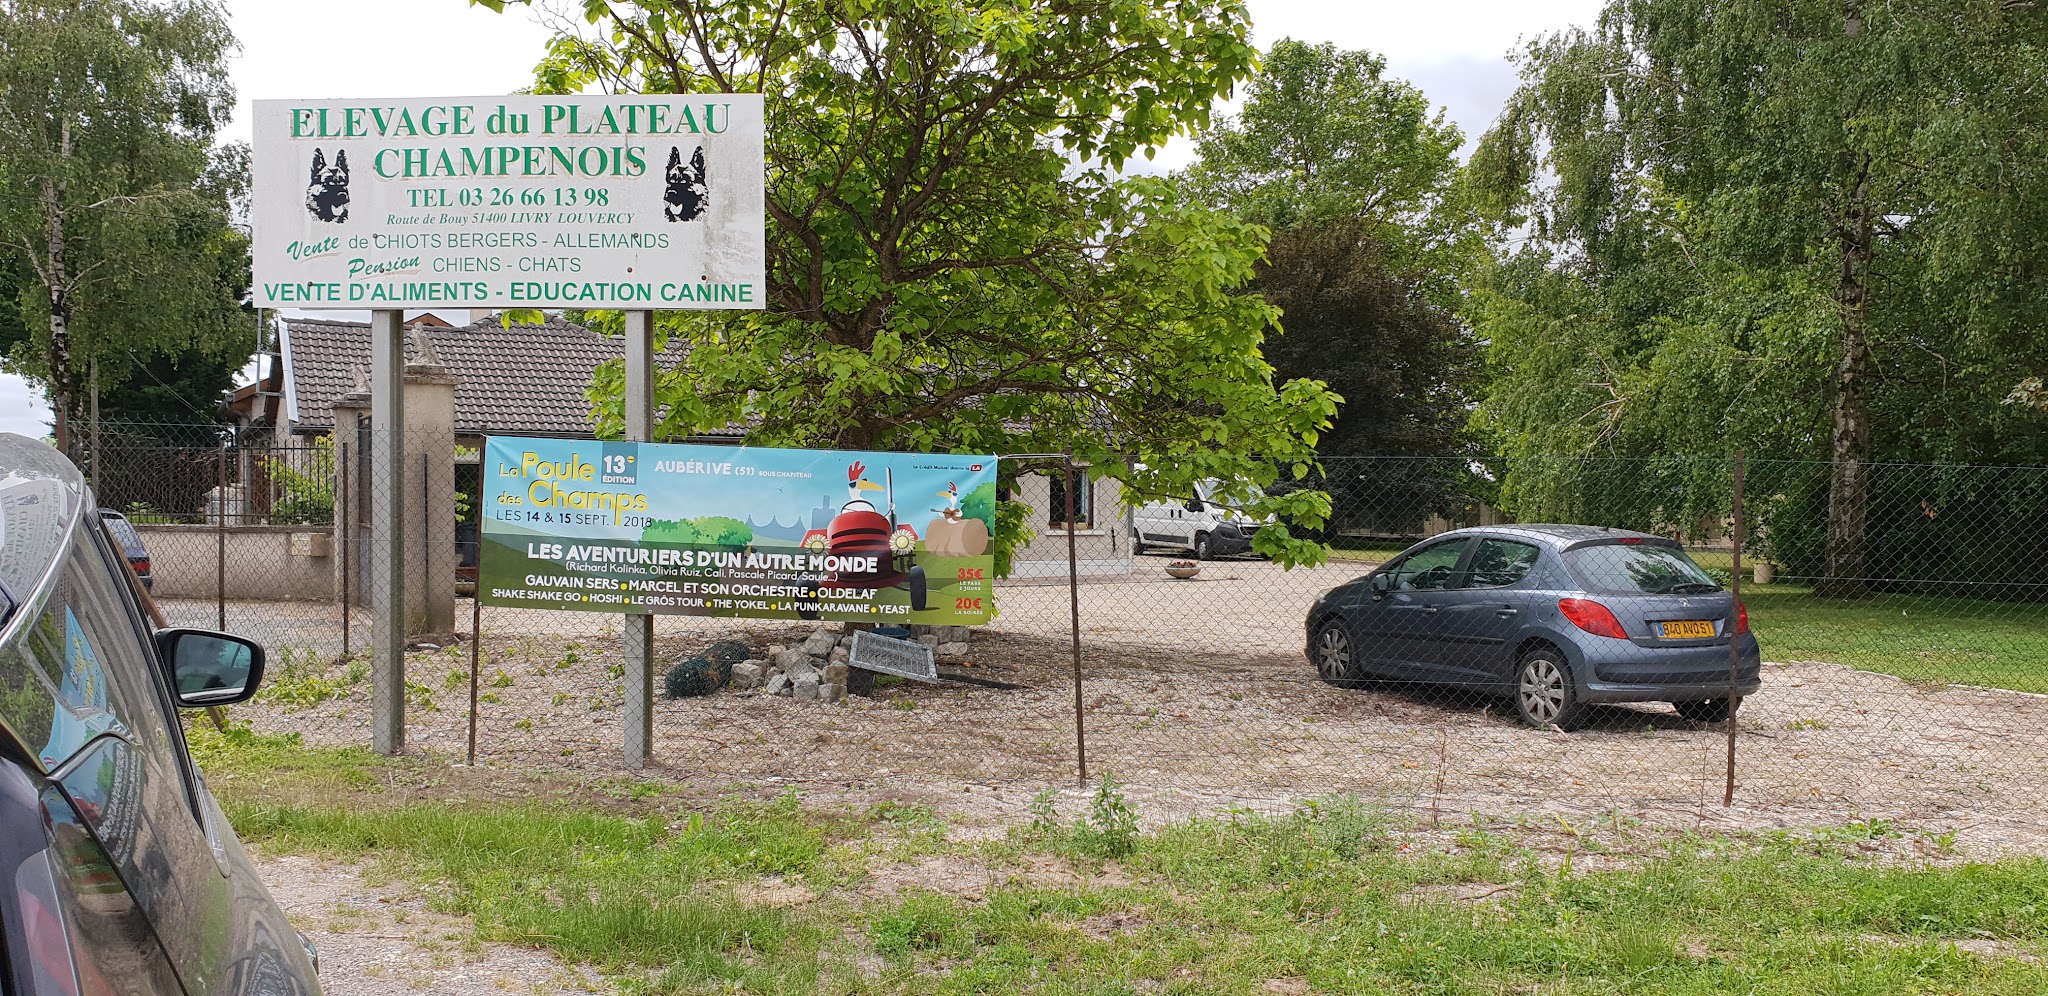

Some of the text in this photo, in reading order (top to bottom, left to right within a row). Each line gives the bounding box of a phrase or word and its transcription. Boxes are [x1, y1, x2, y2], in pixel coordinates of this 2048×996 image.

[290, 103, 731, 138] ELEVAGE du PLATEAU
[374, 146, 648, 178] CHAMPENOIS
[406, 187, 609, 208] TEL 03 26 66 13 98
[386, 212, 636, 229] Route de Bouy 51400 LIVRY LOUVERCY
[286, 237, 340, 260] Vente
[349, 235, 368, 249] de
[374, 233, 442, 249] CHIOTS
[448, 232, 537, 249] BERGERS
[553, 233, 669, 249] ALLEMANDS
[348, 256, 420, 279] Pension
[433, 257, 501, 272] CHIENS
[518, 257, 581, 273] CHATS
[264, 283, 341, 301] VENTE
[350, 282, 488, 301] D'ALIMENTS
[510, 282, 651, 302] EDUCATION
[660, 284, 753, 302] CANINE
[499, 451, 596, 482] La Poule
[654, 458, 731, 475] AUBÉRIVE
[735, 466, 755, 477] (51)
[776, 471, 812, 479] CHAPITEAU
[602, 474, 635, 484] ÉDITION
[497, 480, 648, 527] des Champs
[496, 509, 652, 528] LES 14 & 15 SEPT. 2018
[527, 543, 878, 573] LES AVENTURIERS D'UN AUTRE MONDE
[565, 561, 607, 573] (Richard
[650, 565, 678, 576] Olivia
[729, 569, 765, 579] Pascale
[958, 568, 984, 580] 35€
[525, 574, 583, 589] GAUVAIN
[586, 577, 619, 590] SERS
[629, 580, 681, 593] MARCEL
[683, 582, 699, 594] ET
[701, 583, 729, 595] SON
[732, 584, 808, 598] ORCHESTRE
[817, 587, 878, 600] OLDELAF
[492, 588, 911, 614] SHAKE SHAKE GO HOSHI LE GRÔS TOUR THE YOKEL LA PUNKARAVANE YEAST
[955, 597, 982, 609] 20€
[1663, 623, 1681, 635] 840
[1700, 623, 1712, 634] 51
